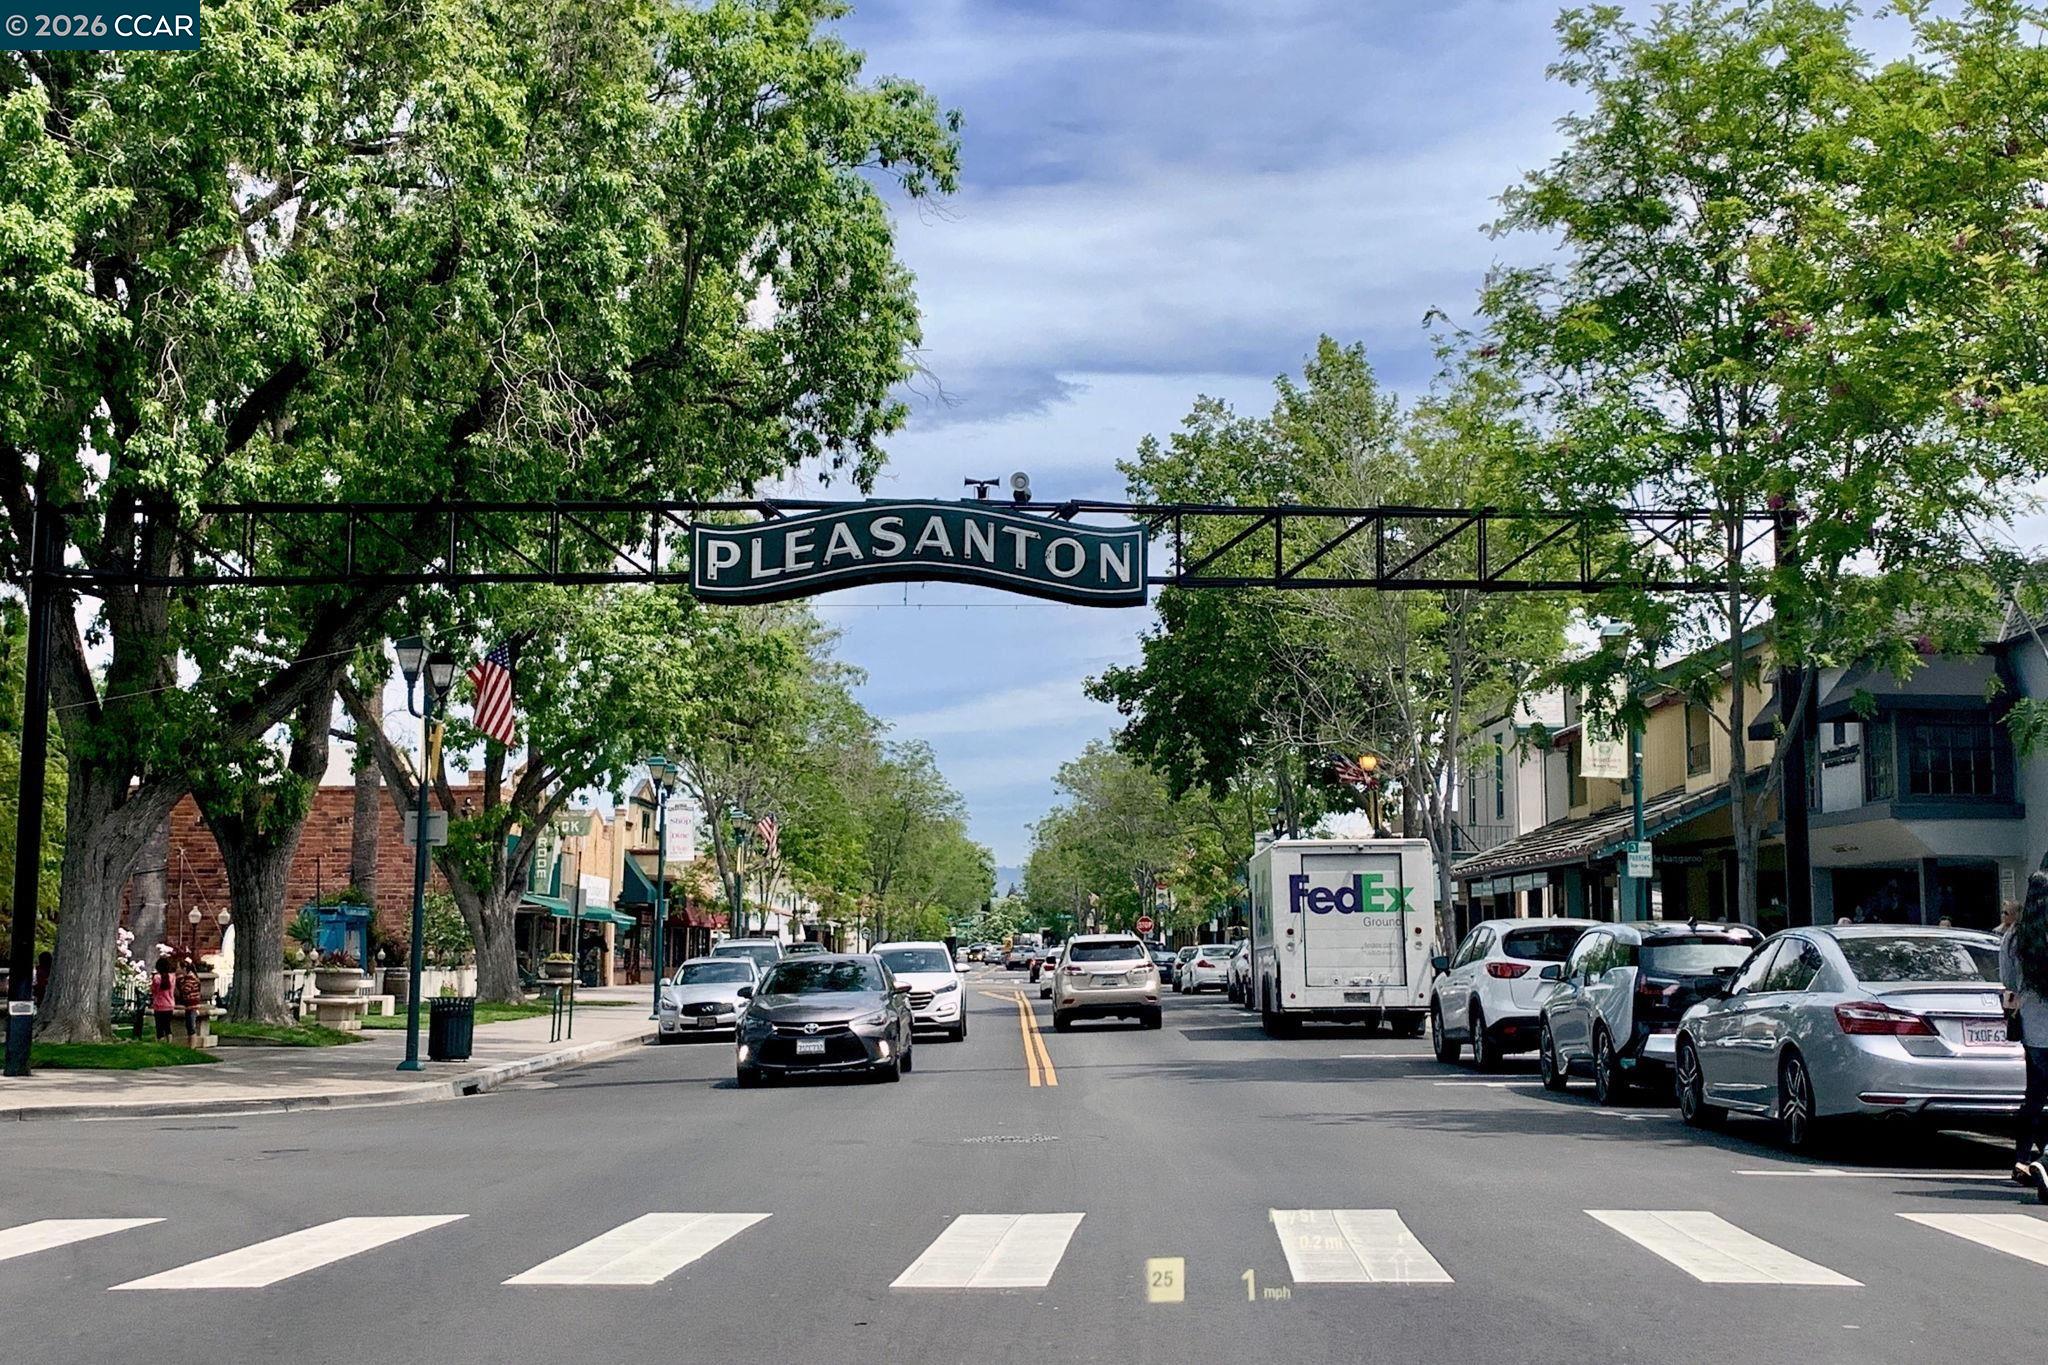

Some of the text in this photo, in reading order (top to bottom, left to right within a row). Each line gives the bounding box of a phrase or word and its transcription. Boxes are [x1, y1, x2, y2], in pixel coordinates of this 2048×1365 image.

[706, 515, 1131, 584] PLEASANTON
[1288, 873, 1416, 914] FedEx
[1362, 916, 1403, 927] Ground
[1151, 1270, 1174, 1288] 25
[1240, 1268, 1291, 1302] 1 mph
